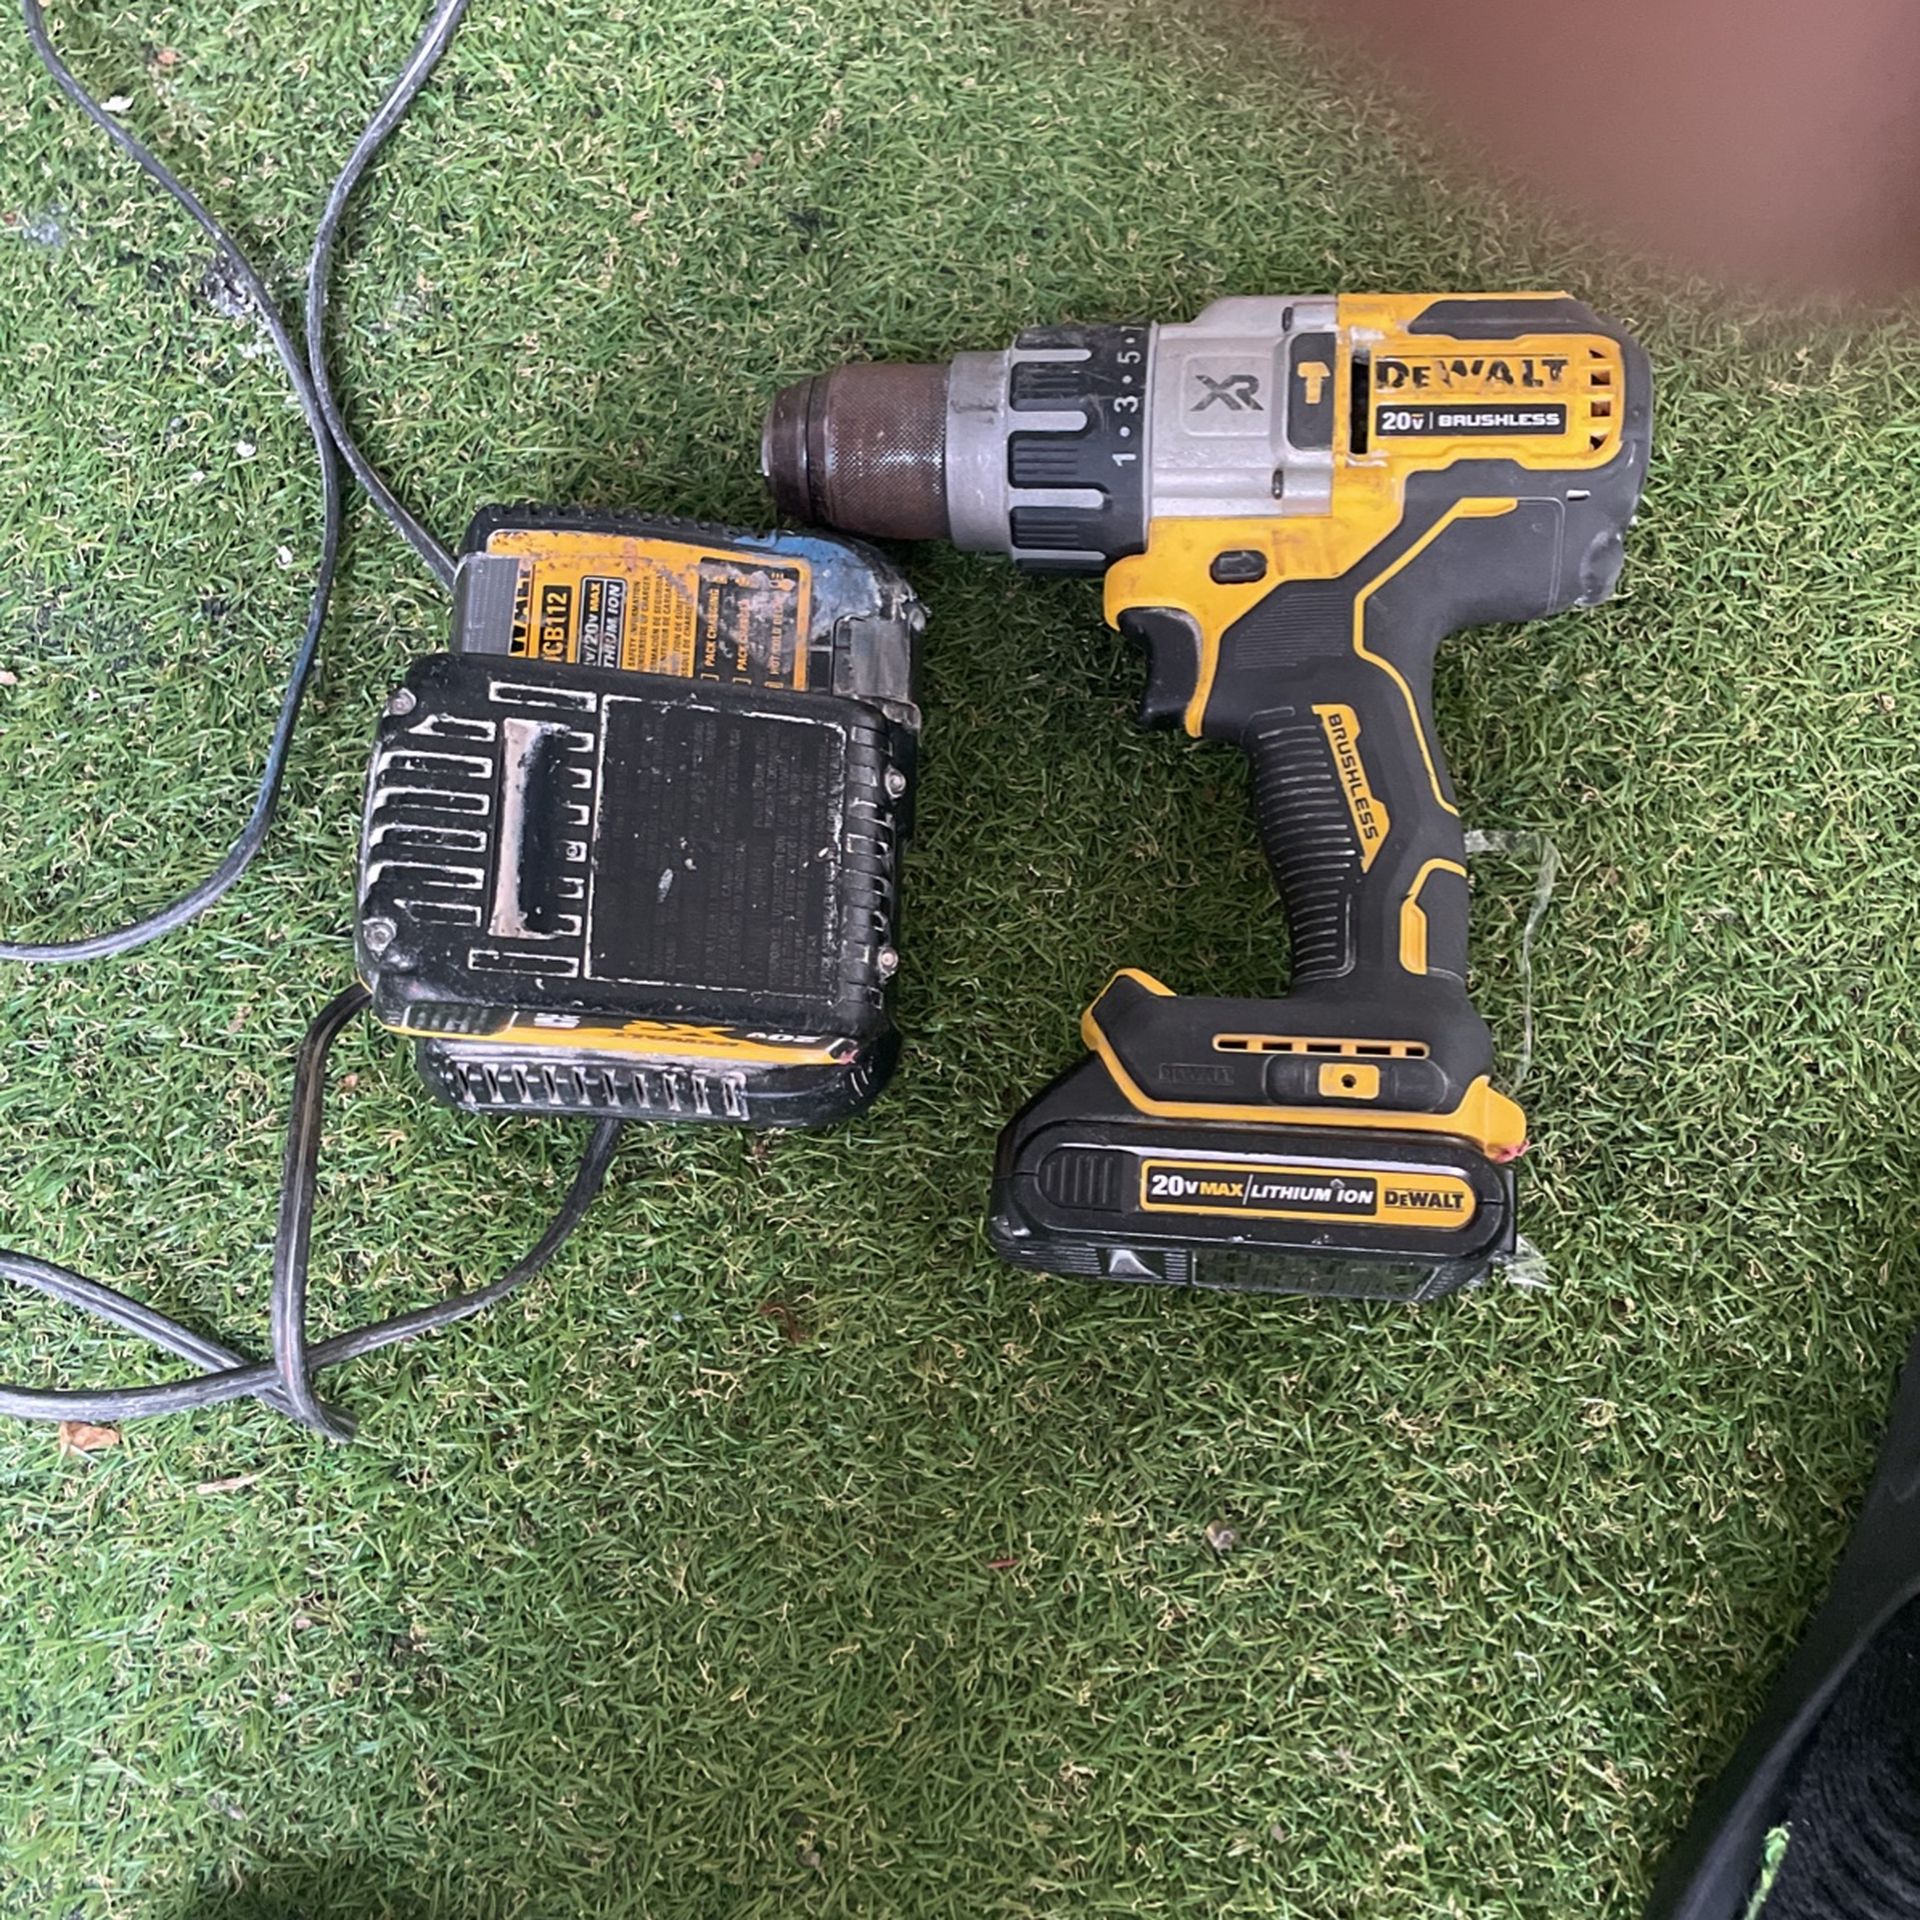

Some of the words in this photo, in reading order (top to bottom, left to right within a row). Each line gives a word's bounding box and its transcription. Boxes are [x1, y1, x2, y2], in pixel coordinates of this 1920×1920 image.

[1116, 351, 1141, 364] 5
[1113, 395, 1139, 413] 3
[1190, 374, 1264, 411] XR
[1438, 413, 1560, 427] BRUSHLESS
[1112, 453, 1137, 467] 1
[589, 583, 601, 612] MAX
[607, 584, 621, 614] ION
[706, 588, 720, 639] CHARGING
[627, 638, 637, 667] SAFETY
[704, 641, 717, 667] PACK
[736, 643, 748, 671] PACK
[1328, 713, 1379, 840] BRUSHLESS
[1199, 1181, 1244, 1197] MAX
[1250, 1184, 1331, 1202] LITHIUM
[1336, 1187, 1375, 1204] ION
[1384, 1190, 1465, 1209] DEWALT
